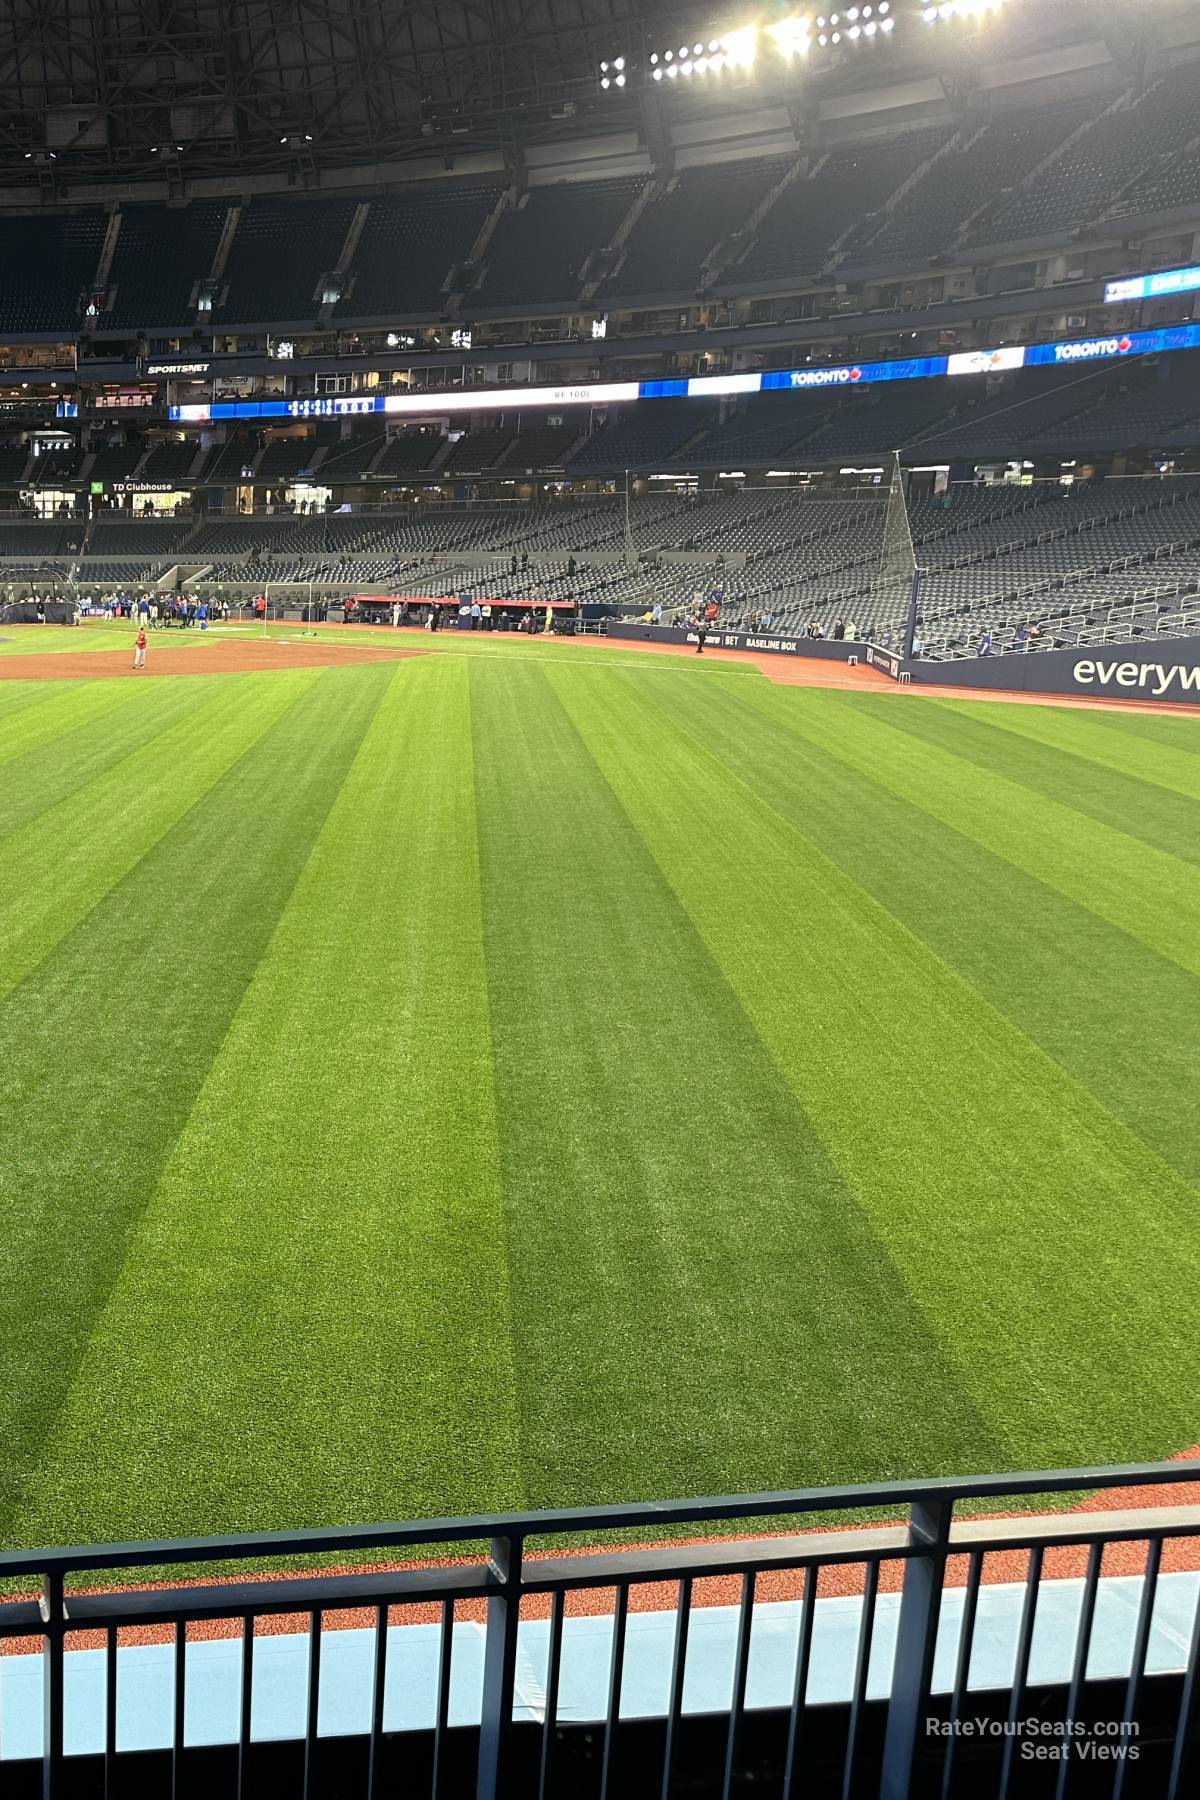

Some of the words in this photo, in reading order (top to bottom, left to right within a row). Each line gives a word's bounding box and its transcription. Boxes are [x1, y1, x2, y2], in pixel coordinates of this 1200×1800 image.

[1055, 339, 1118, 360] TORONTO
[147, 364, 210, 375] SPORTSNET
[790, 369, 850, 386] TORONTO
[112, 483, 125, 492] TD
[126, 482, 173, 491] Clubhouse
[725, 635, 740, 646] BET
[746, 638, 780, 650] BASELINE
[781, 641, 797, 651] BOX
[1073, 659, 1200, 695] everyw
